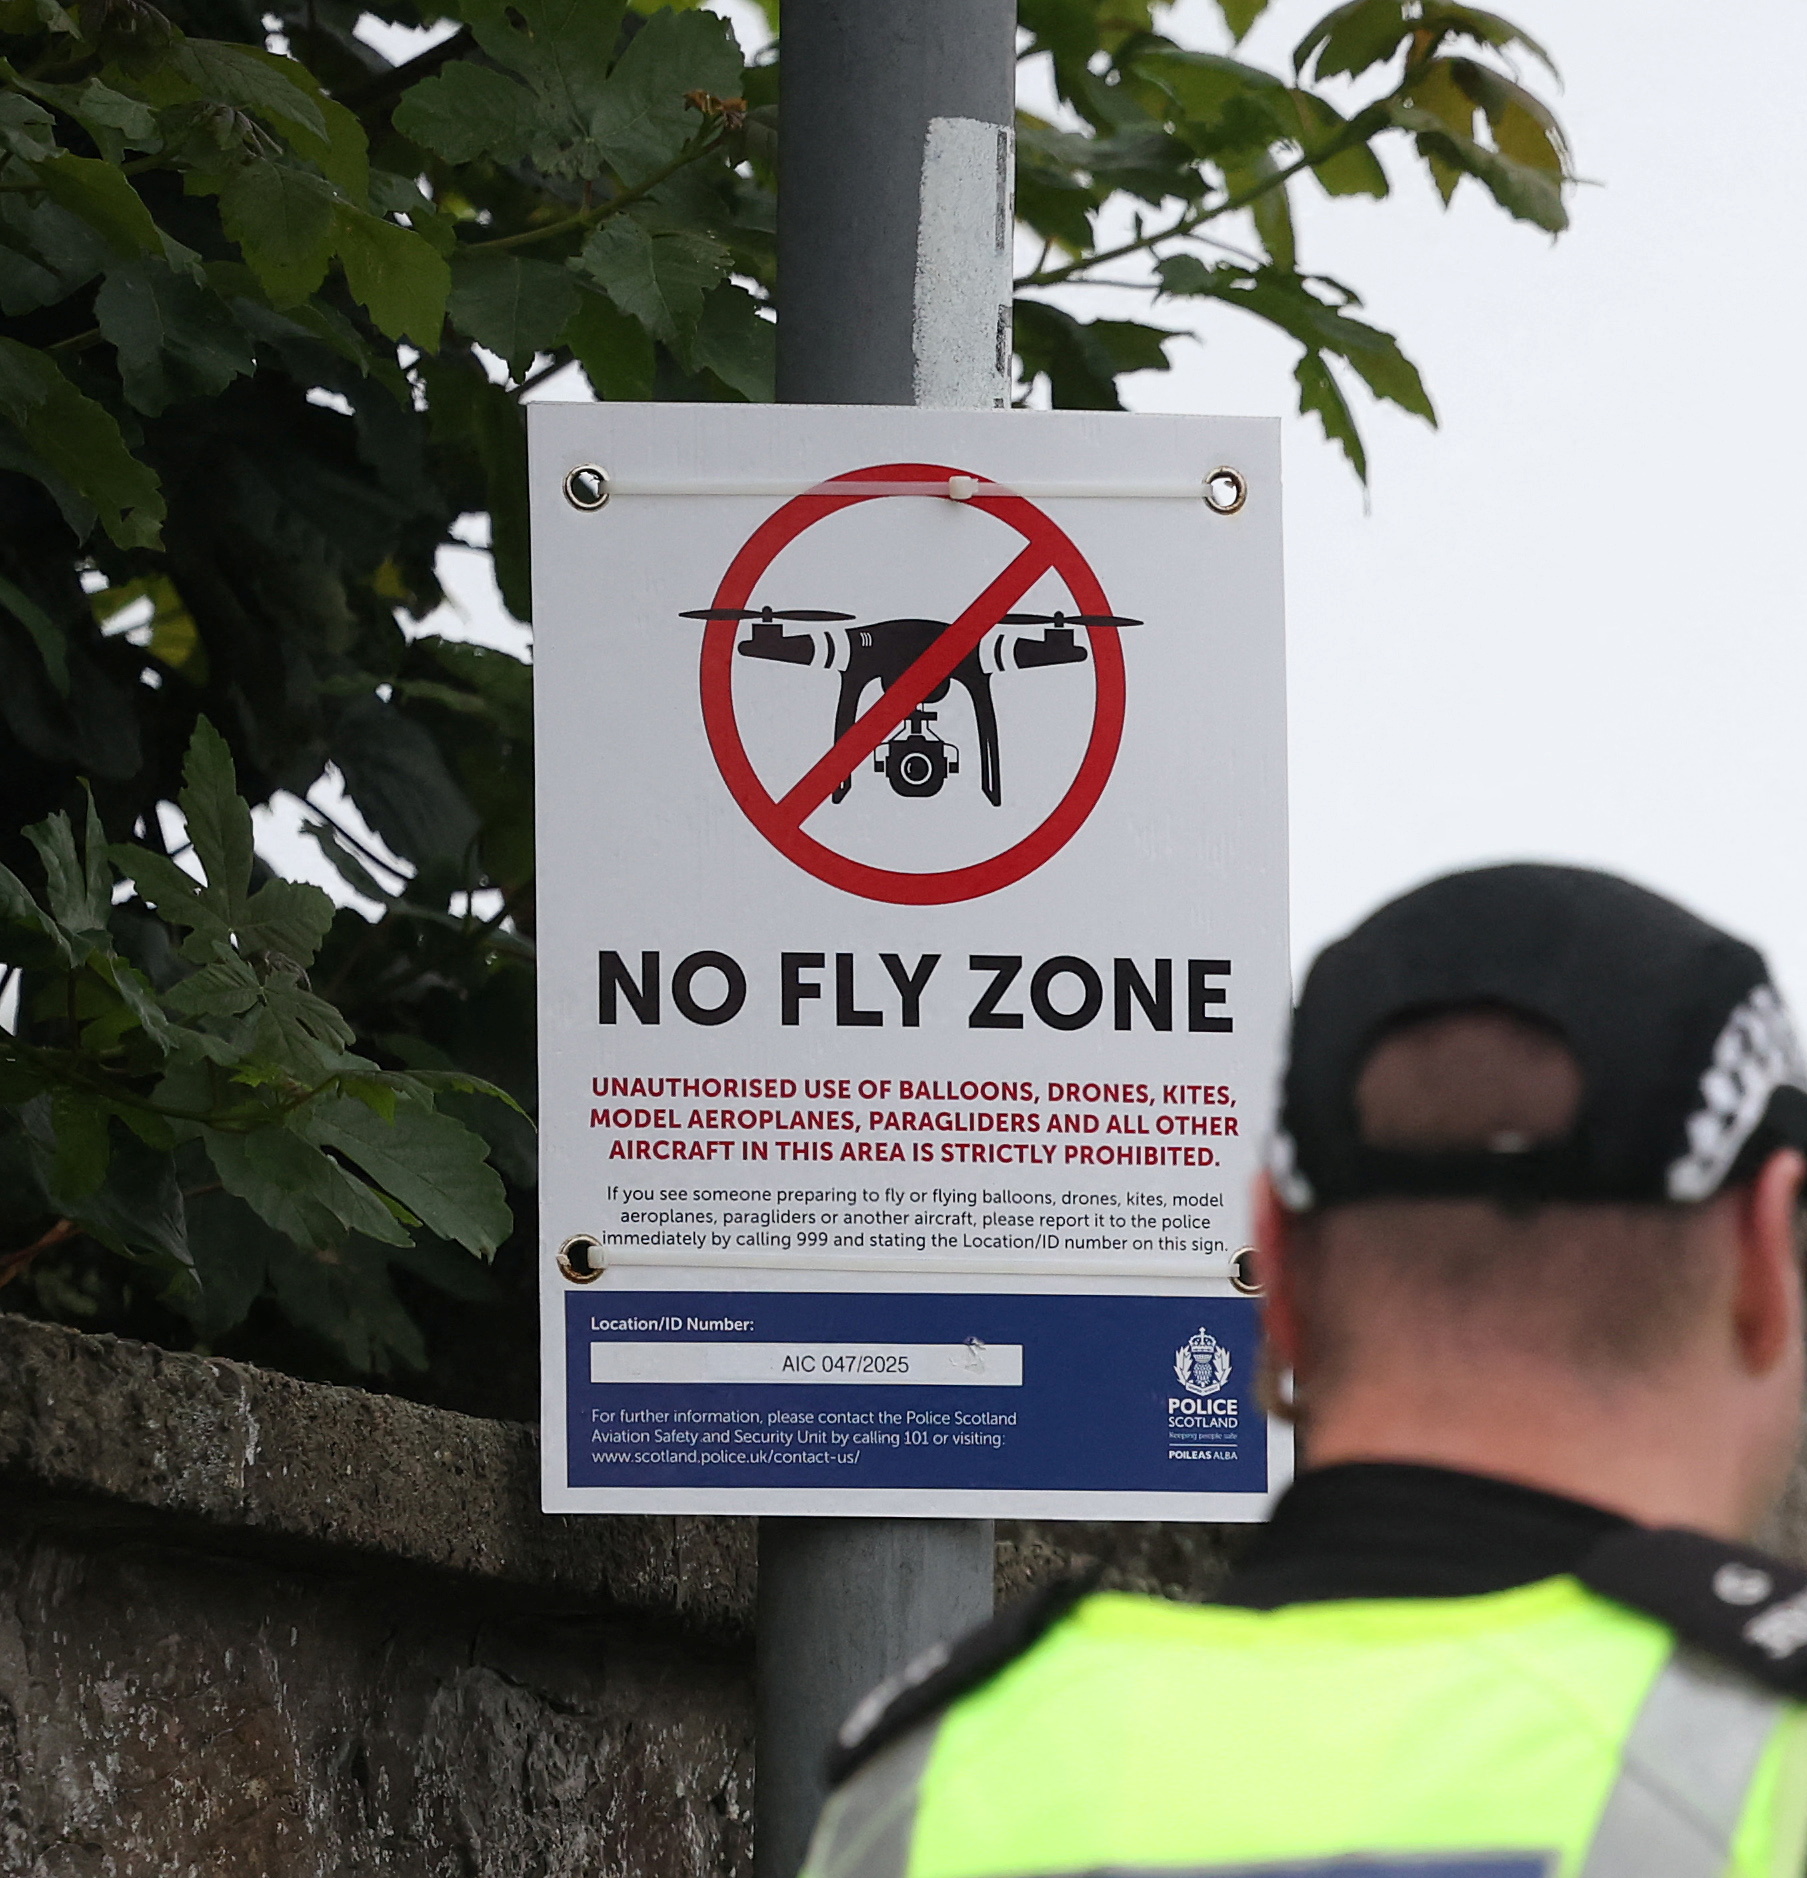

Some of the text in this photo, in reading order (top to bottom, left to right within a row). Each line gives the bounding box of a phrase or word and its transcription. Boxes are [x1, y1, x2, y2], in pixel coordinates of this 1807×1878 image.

[598, 948, 1234, 1034] NO FLY ZONE
[592, 1076, 1237, 1108] UNAUTHORISED USE OF BALLOONS, DRONES, KITES,
[589, 1107, 1239, 1137] MODEL AEROPLANES, PARAGLIDERS AND ALL OTHER
[608, 1138, 1220, 1167] AIRCRAFT IN THIS AREA IS STRICTLY PROHIBITED.
[607, 1185, 1224, 1208] If you see someone preparing to fly or flying balloons, drones, kites, model
[620, 1207, 1211, 1233] aeroplanes, paragliders or another aircraft, please report it to the police
[602, 1229, 1228, 1256] immediately by calling 999 and stating the Location/ID number on this sign.
[591, 1315, 754, 1332] Location/ID Number:
[782, 1354, 910, 1374] AIC 047/2025
[1168, 1398, 1238, 1415] POLICE
[591, 1408, 616, 1423] For
[620, 1408, 670, 1424] further
[767, 1409, 815, 1428] please
[817, 1411, 875, 1425] contact
[878, 1410, 903, 1426] the
[906, 1410, 951, 1426] Police
[954, 1410, 1017, 1426] Scotland
[1168, 1416, 1238, 1429] SCOTLAND
[591, 1428, 1005, 1449] Aviation Safety and Security Unit by calling 101 or visiting:
[591, 1447, 861, 1468] www.scotland.police.uk/contact-us/
[1168, 1450, 1238, 1460] POILEAS ALBA
